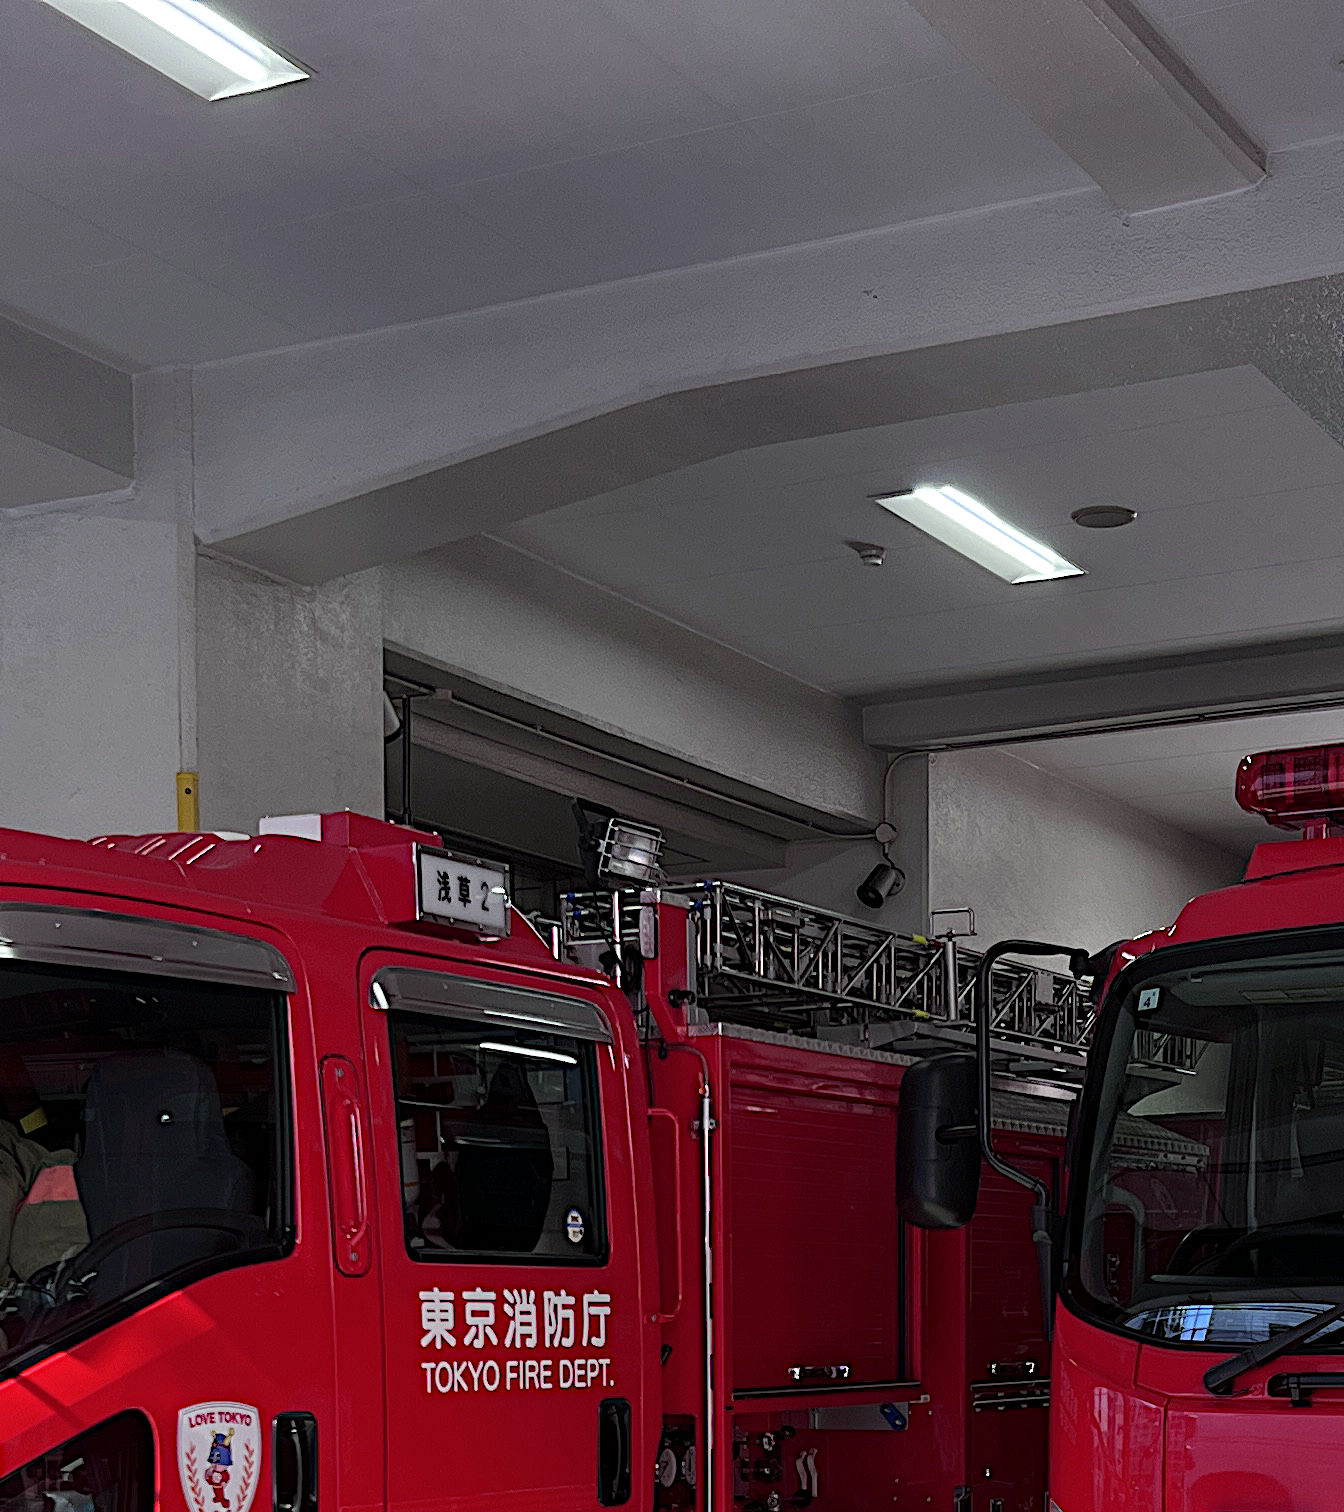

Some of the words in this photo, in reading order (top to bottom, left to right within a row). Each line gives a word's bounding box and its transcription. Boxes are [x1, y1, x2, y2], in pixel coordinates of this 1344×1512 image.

[418, 1287, 611, 1350] 東京消防庁
[421, 1360, 500, 1394] TOKYO
[506, 1359, 553, 1391] FIRE
[559, 1358, 615, 1389] DEPT.
[188, 1411, 216, 1429] LOVE
[218, 1411, 253, 1427] TOKYO
